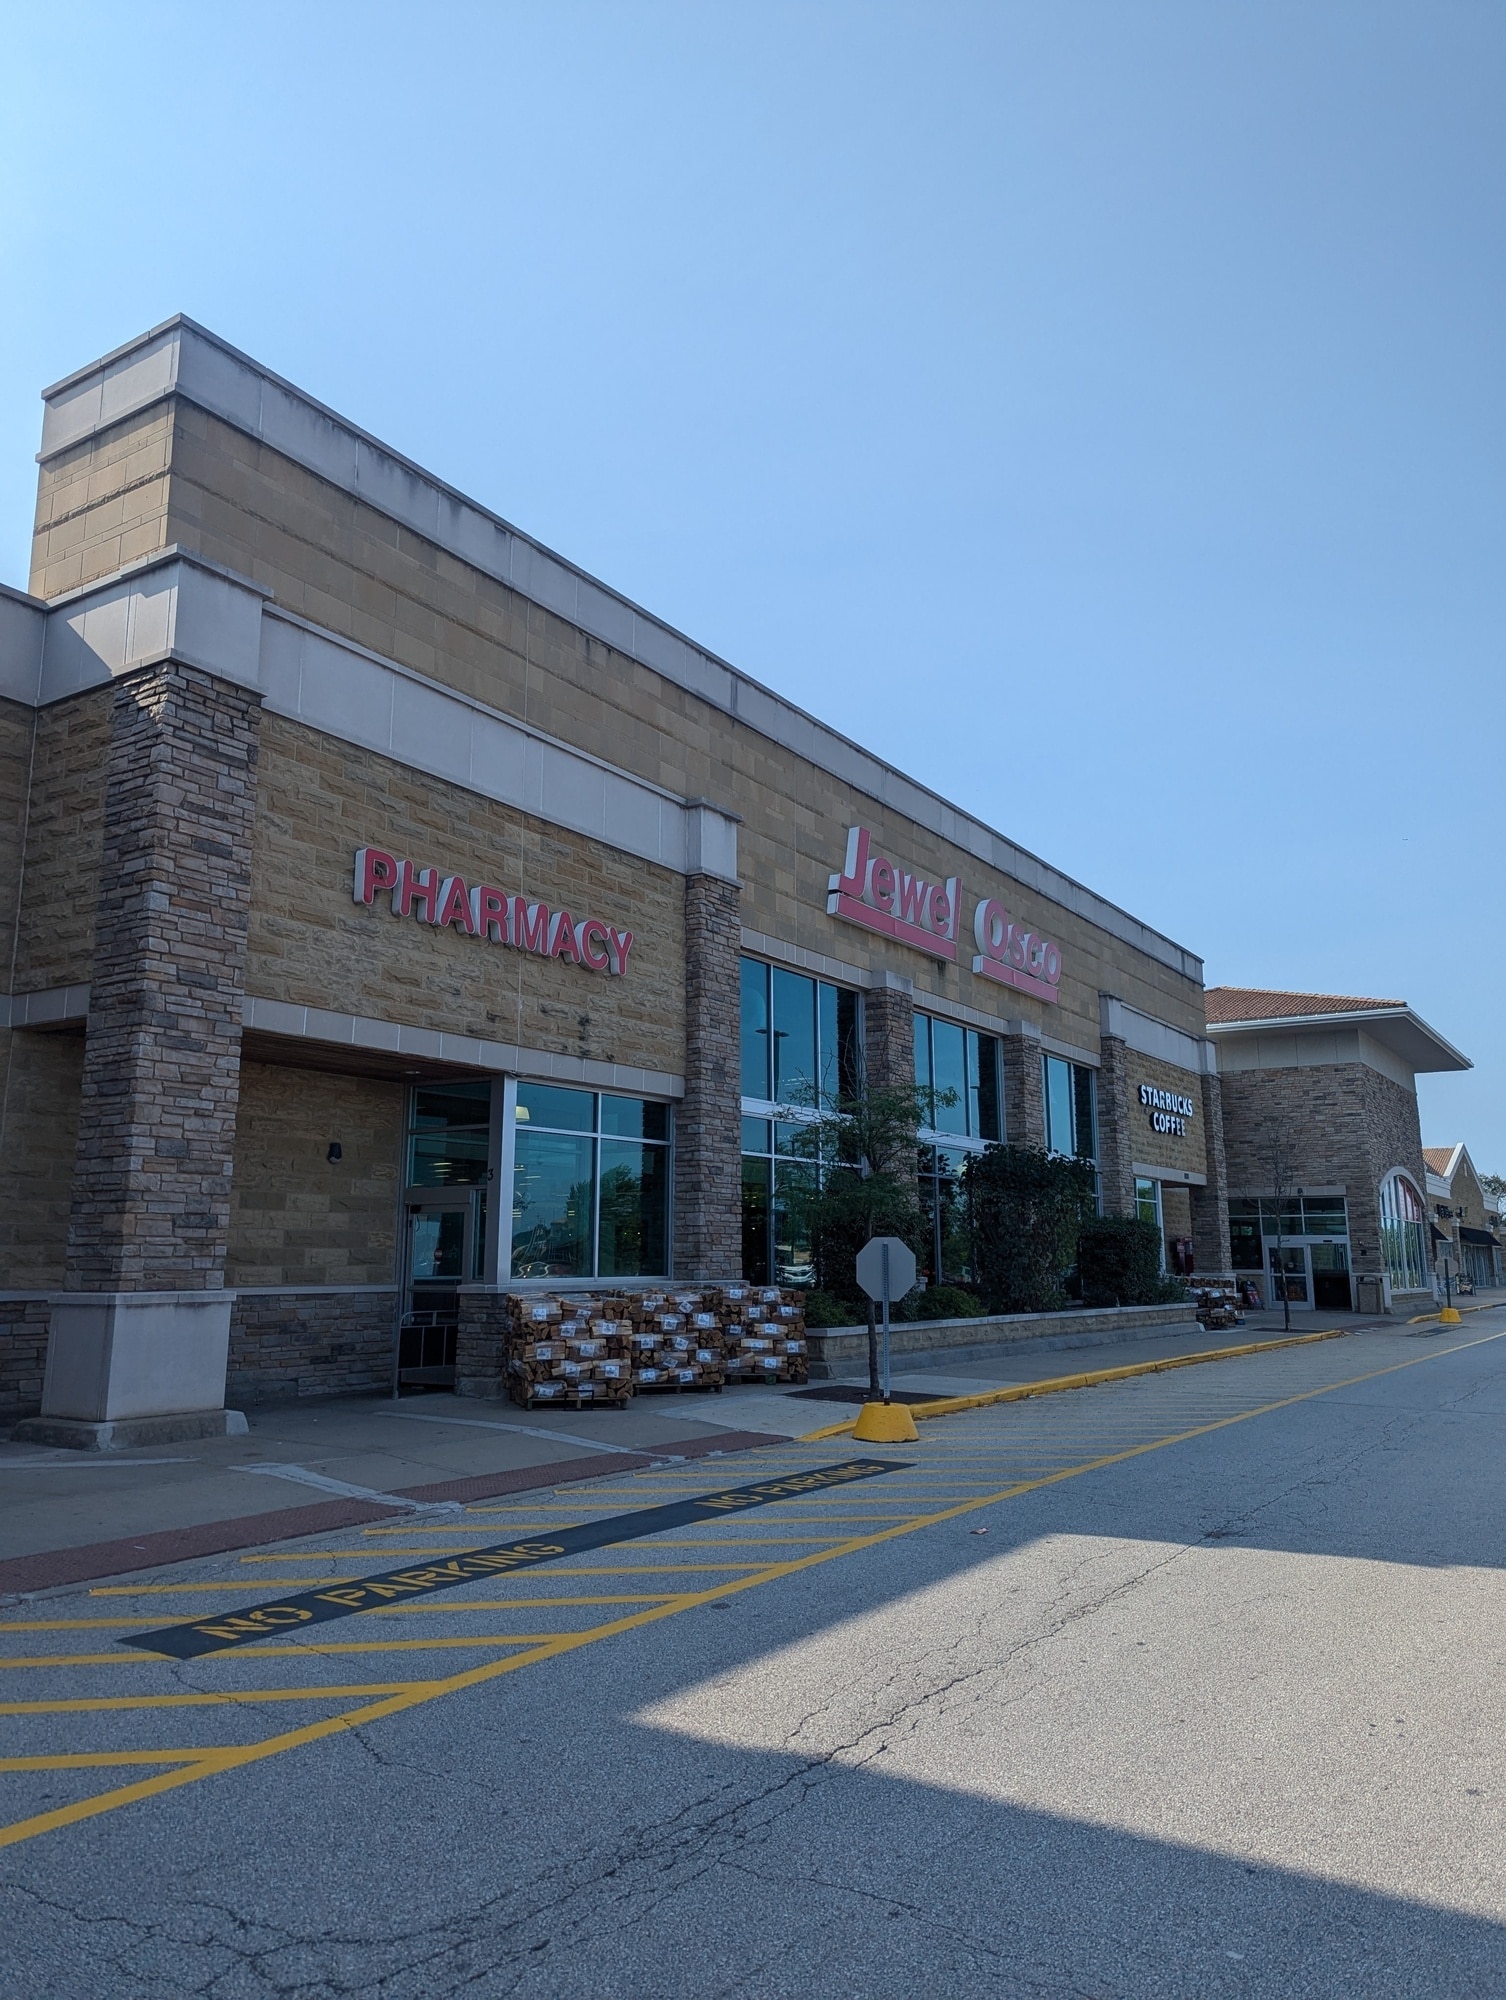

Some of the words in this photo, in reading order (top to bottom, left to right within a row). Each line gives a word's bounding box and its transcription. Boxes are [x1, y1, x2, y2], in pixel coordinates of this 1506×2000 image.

[353, 848, 633, 976] PHARMACY
[828, 826, 962, 942] Jewel
[974, 898, 1061, 985] Osco
[1138, 1084, 1193, 1117] STARBUCKS
[1151, 1111, 1186, 1137] COFFEE
[692, 1494, 763, 1509] NO
[752, 1464, 885, 1495] PARKING
[191, 1606, 313, 1640] NO
[314, 1543, 565, 1607] PARKING
